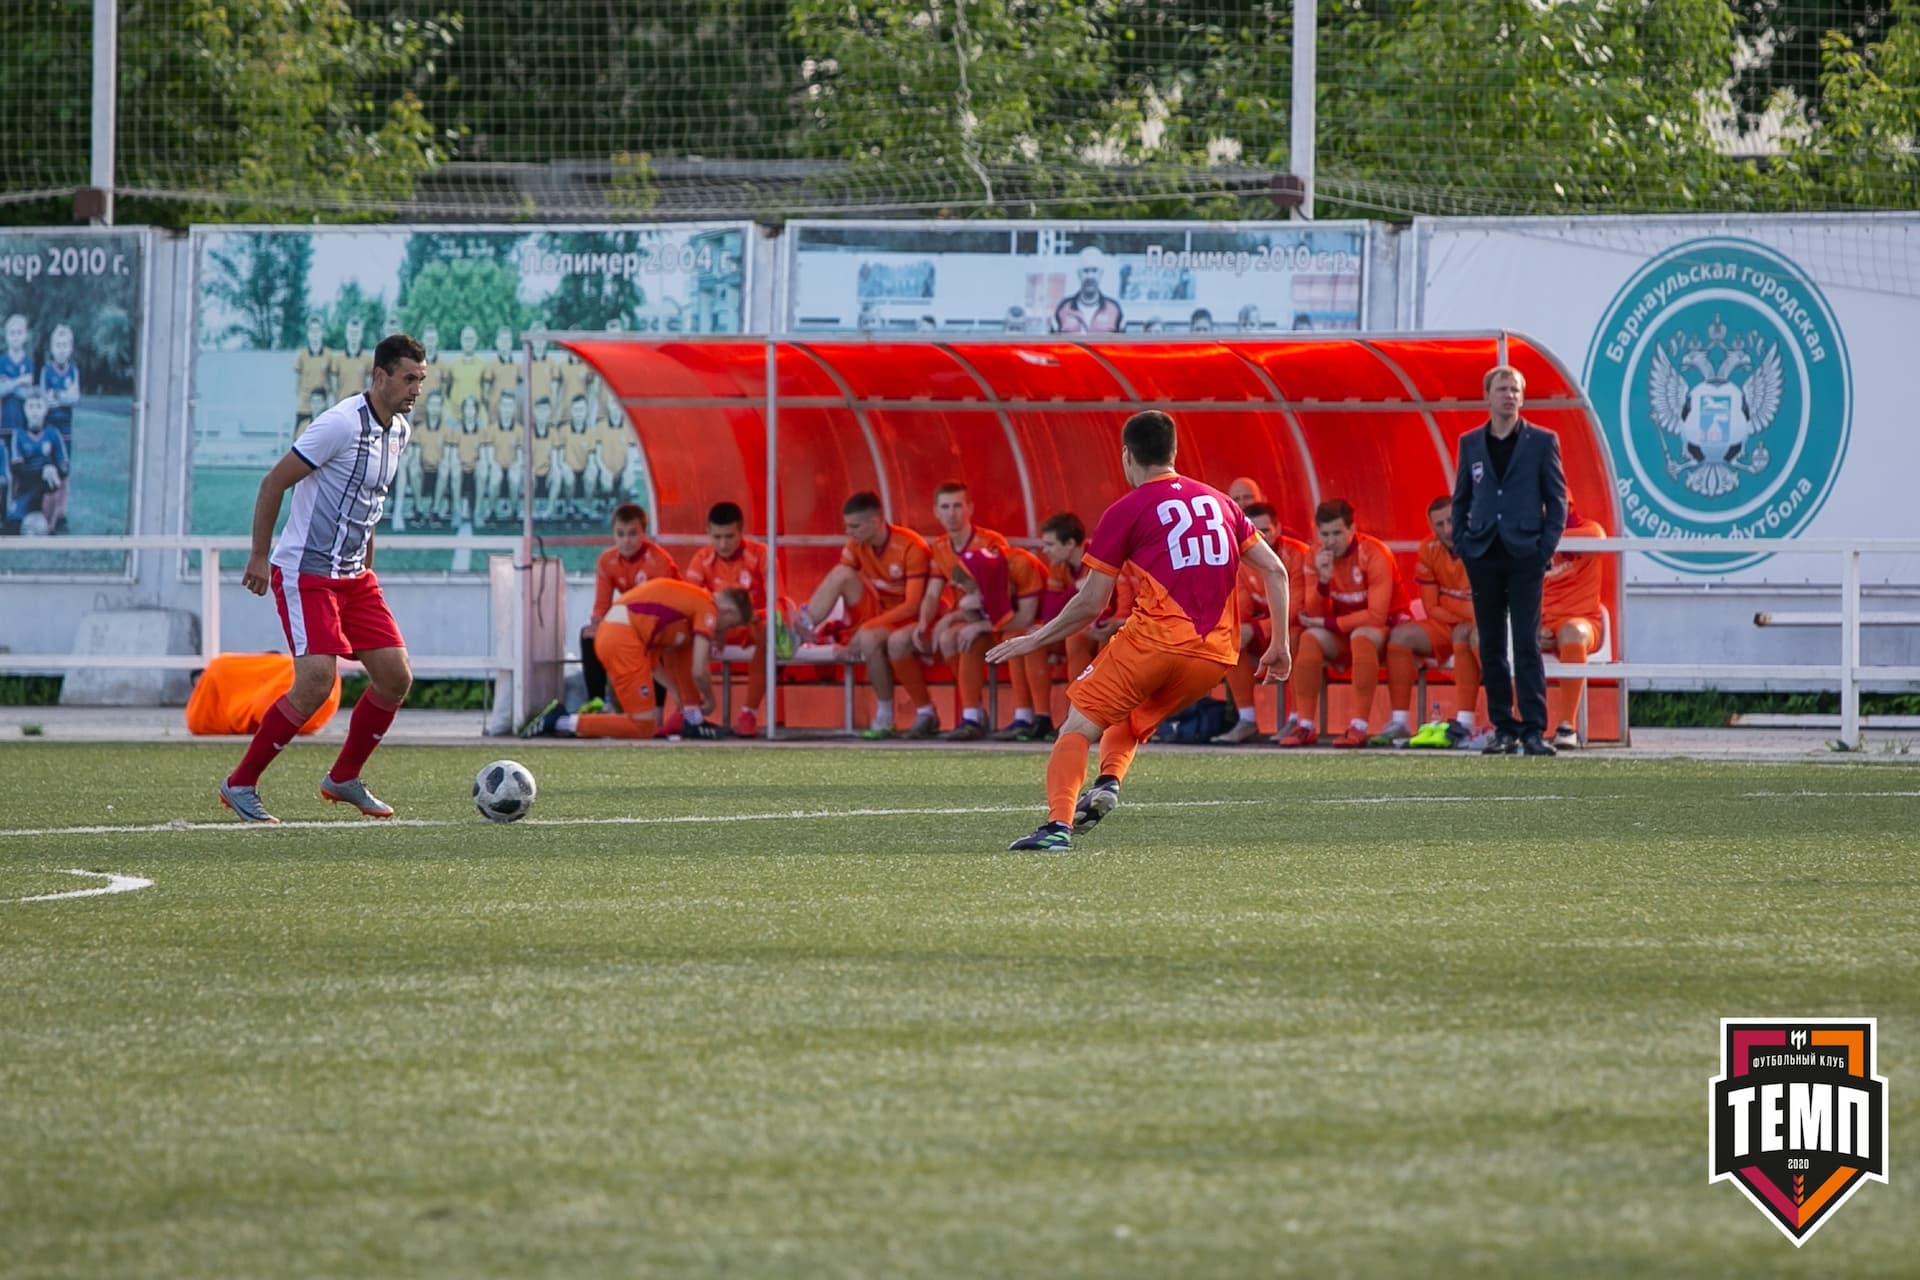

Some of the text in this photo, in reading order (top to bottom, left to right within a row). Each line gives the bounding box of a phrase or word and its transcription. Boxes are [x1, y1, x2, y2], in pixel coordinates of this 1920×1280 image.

[47, 246, 107, 276] 2010
[112, 254, 130, 276] г.
[523, 243, 738, 281] Полимер 2004 г.
[1146, 245, 1250, 276] Полимер
[1255, 244, 1312, 272] 2010
[1605, 262, 1826, 364] Барнаульская городская
[1156, 494, 1230, 571] 23
[1728, 476, 1813, 541] футбола
